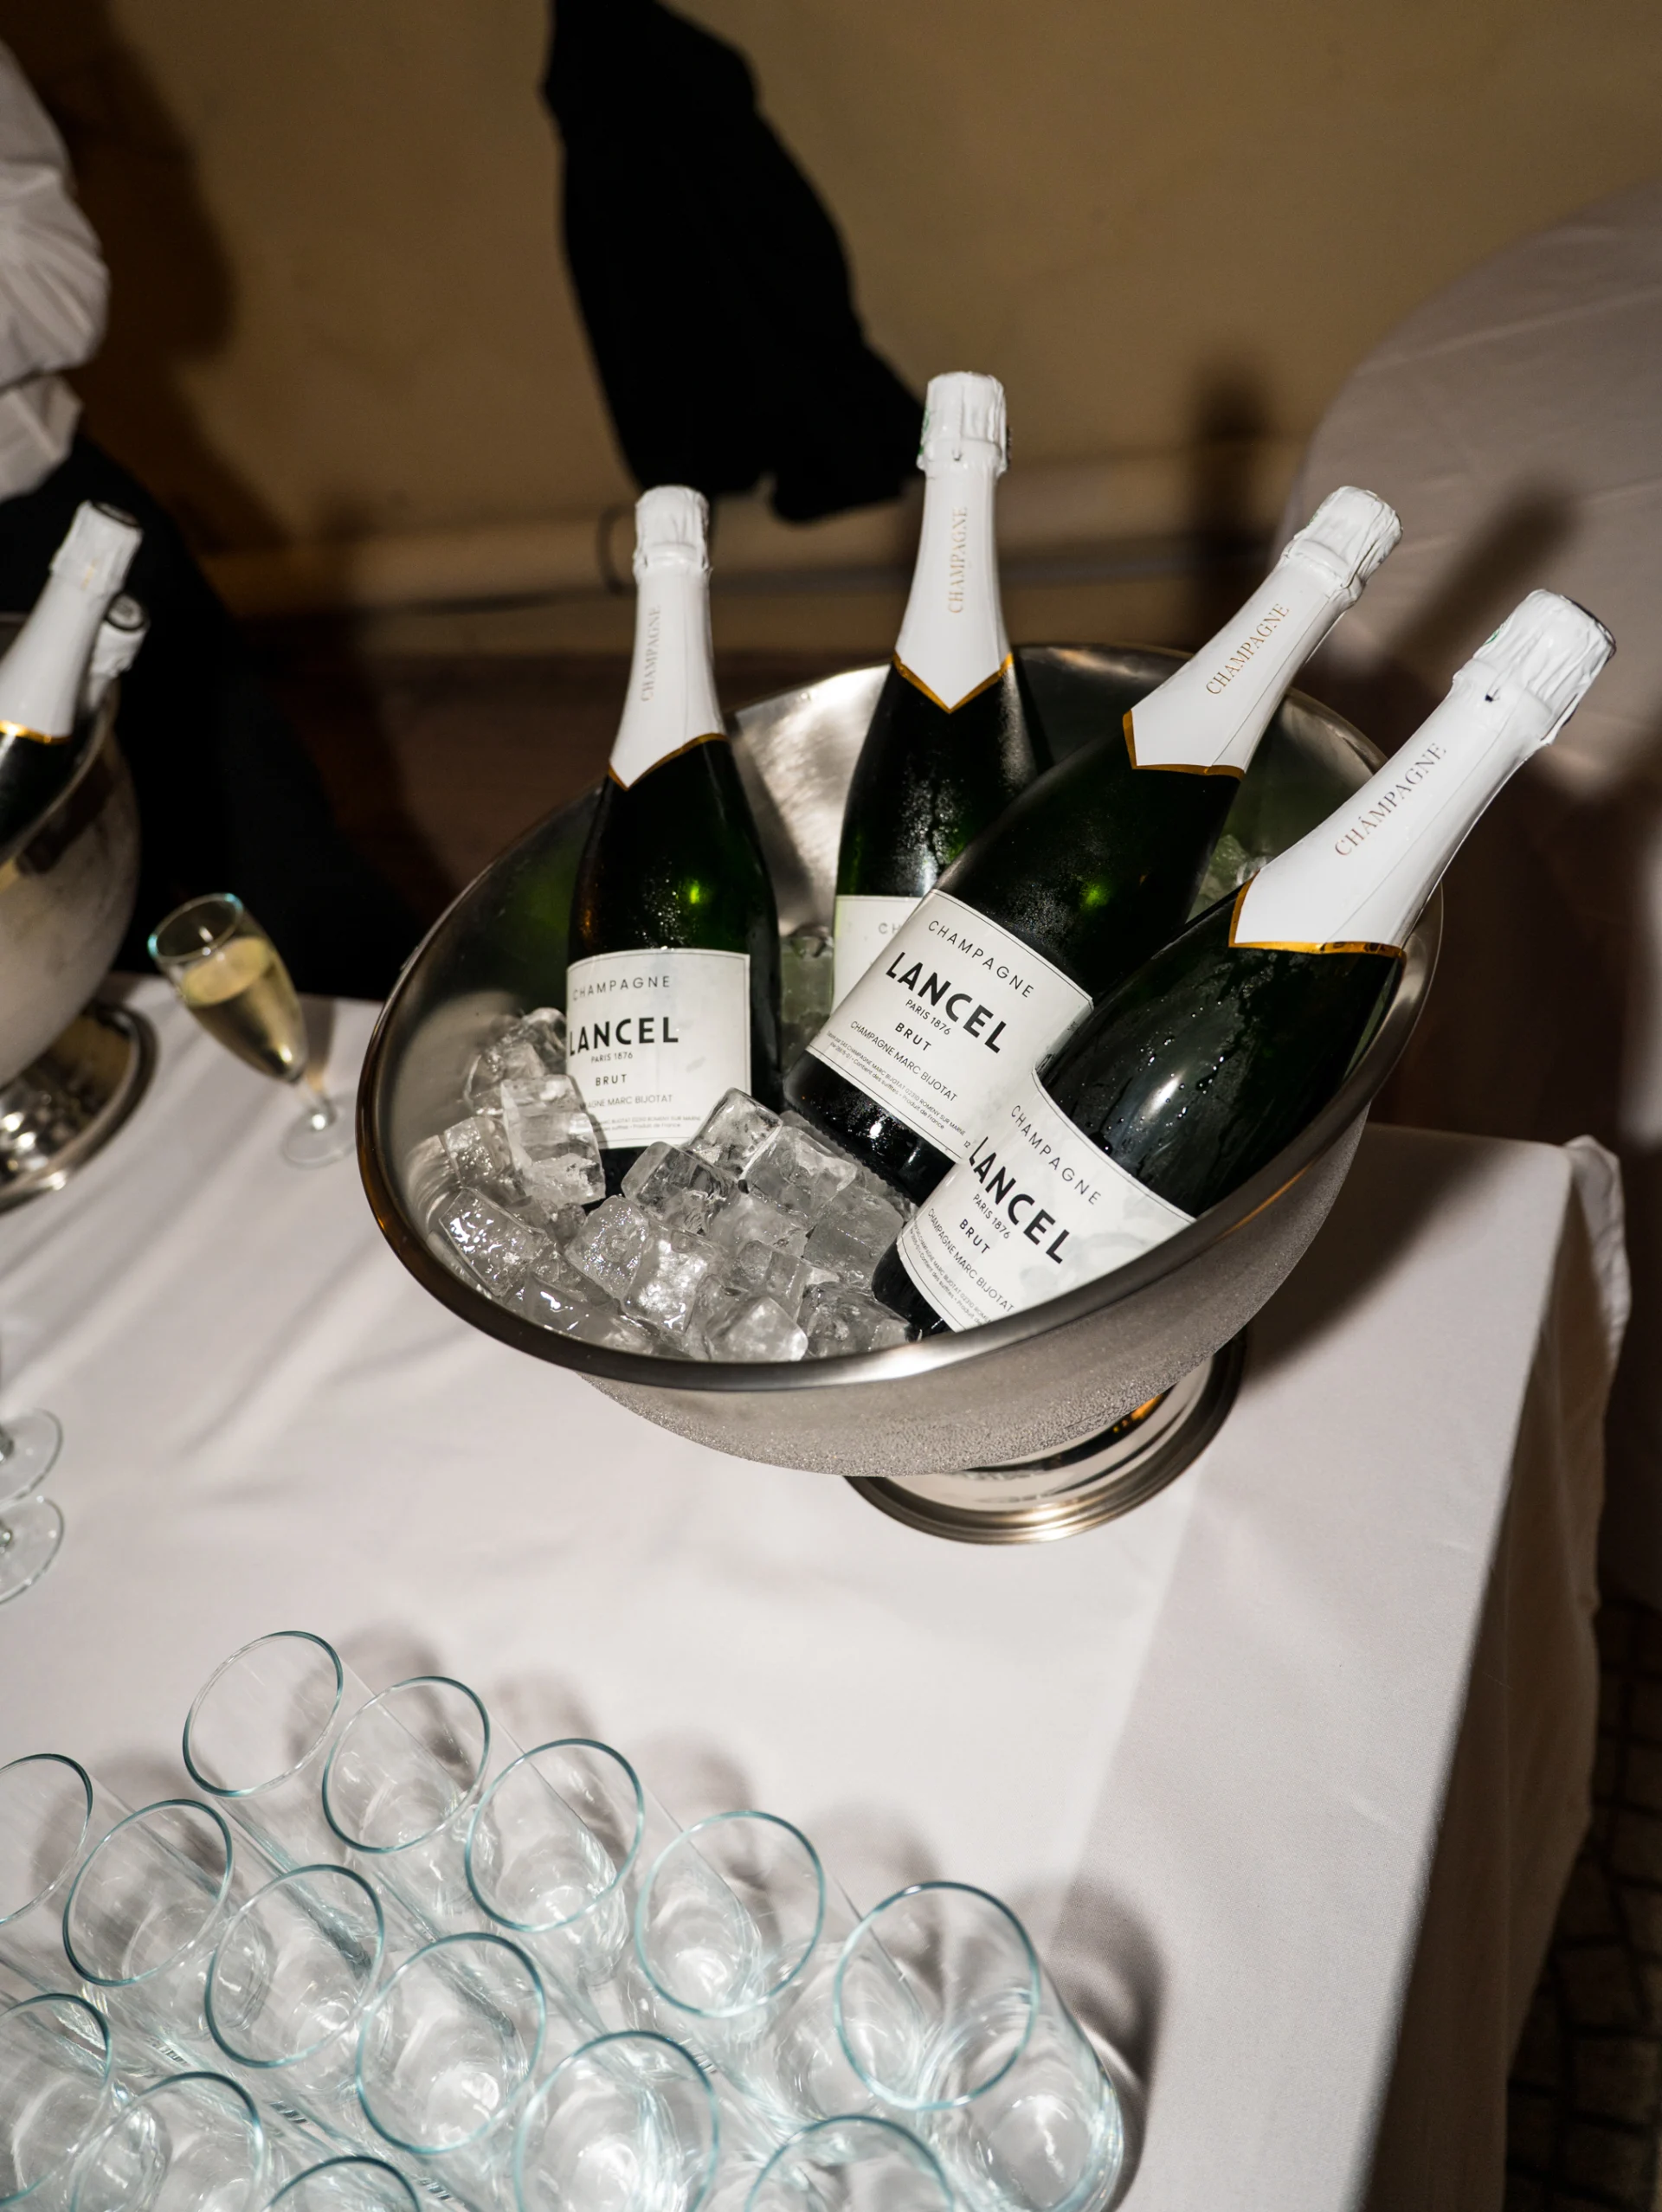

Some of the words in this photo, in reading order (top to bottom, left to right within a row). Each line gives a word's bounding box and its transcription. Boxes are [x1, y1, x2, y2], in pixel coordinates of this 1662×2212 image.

[947, 506, 969, 614] CHAMPAGNE
[641, 605, 662, 703] CHAMPAGNE
[1206, 603, 1290, 695] CHAMPAGNE
[1334, 742, 1447, 857] CHAMPAGNE
[572, 974, 672, 1002] CHAMPAGNE
[928, 920, 1034, 998] CHAMPAGNE
[569, 1016, 680, 1057] LANCEL
[886, 951, 1008, 1054] LANCEL
[895, 1022, 932, 1052] BRUT
[905, 999, 931, 1020] PARIS
[930, 1017, 952, 1036] 1876
[591, 1053, 611, 1064] PARIS
[614, 1051, 634, 1061] 1876
[596, 1074, 627, 1087] BRUT
[850, 1020, 895, 1056] CHAMPAGNE
[893, 1051, 921, 1075] MARC
[921, 1071, 958, 1102] BIJOTAT
[608, 1096, 633, 1106] MARC
[635, 1094, 673, 1104] BIJOTAT
[1011, 1105, 1101, 1206] CHAMPAGNE
[959, 1219, 990, 1254] BRUT
[969, 1136, 1070, 1264] LANCEL
[973, 1193, 993, 1219] PARIS
[991, 1218, 1011, 1239] 1876
[928, 1208, 957, 1255] CHAMPAGNE
[953, 1251, 978, 1279] MARC
[976, 1277, 1015, 1313] BIJOTAT
